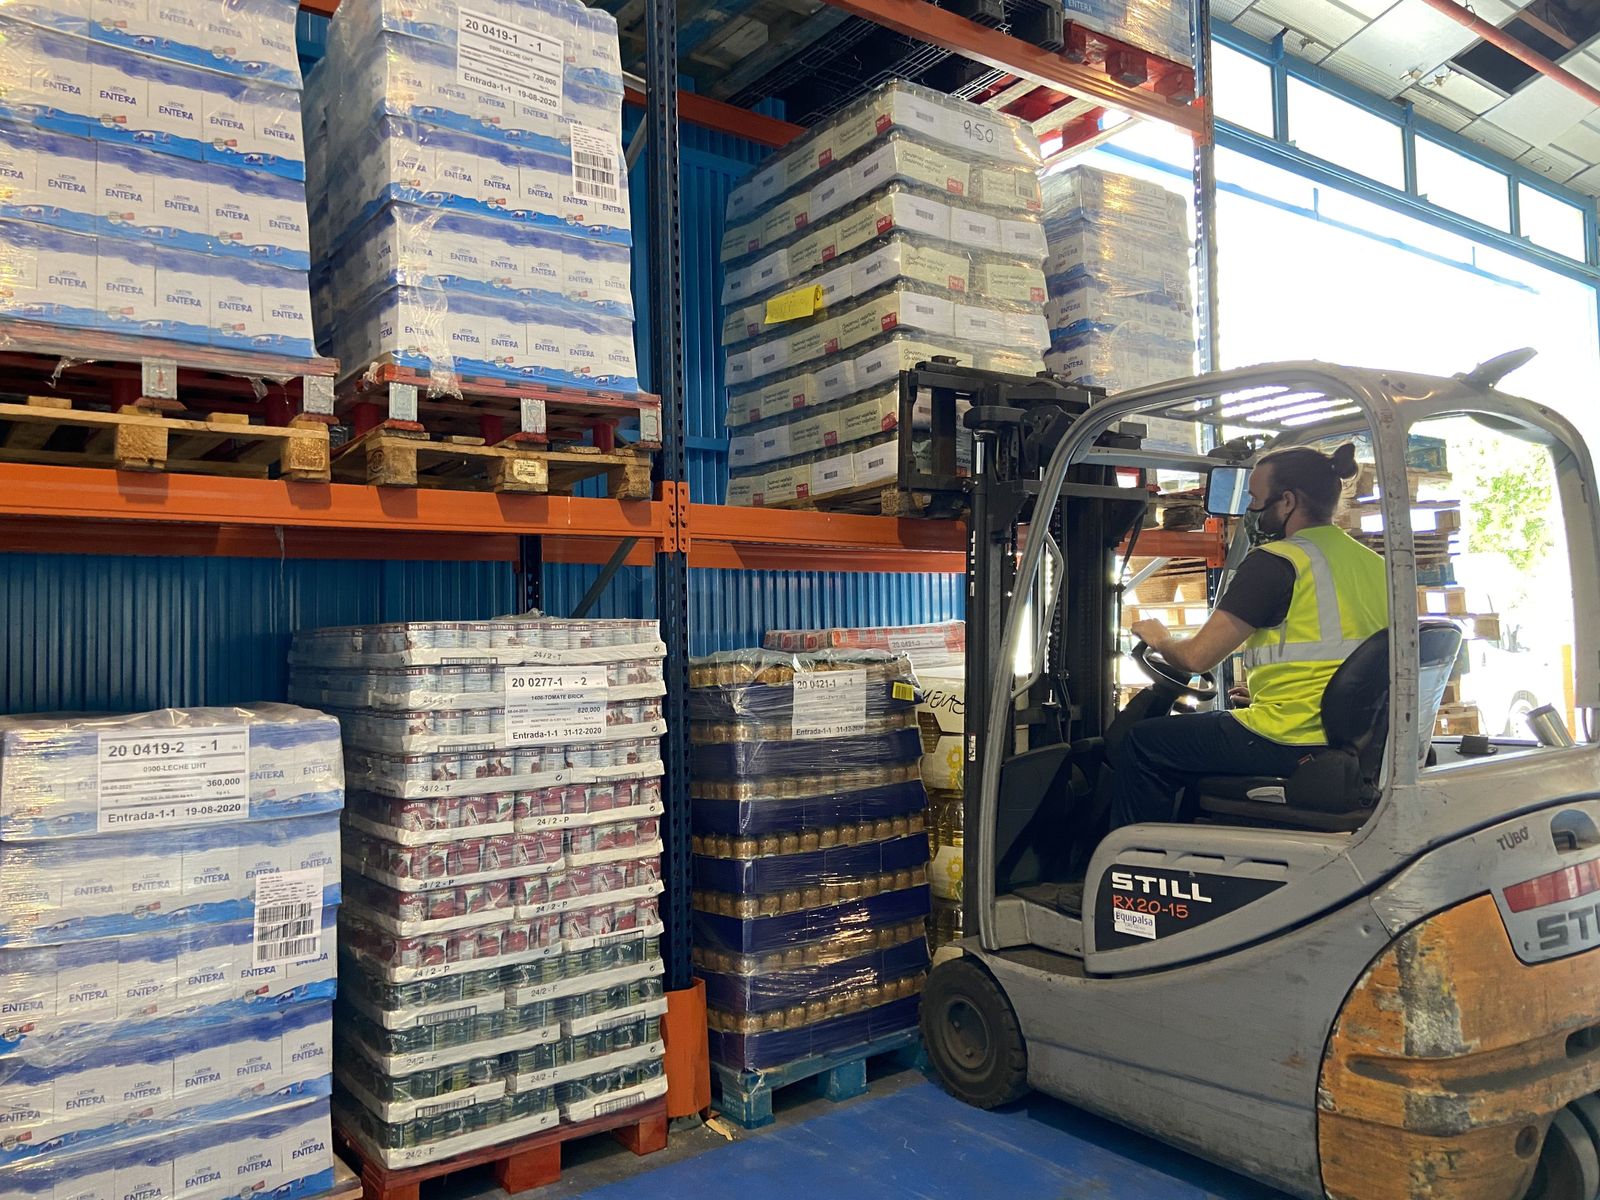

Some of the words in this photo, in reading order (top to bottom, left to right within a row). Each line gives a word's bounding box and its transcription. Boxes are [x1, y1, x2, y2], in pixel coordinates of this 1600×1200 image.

[465, 19, 479, 31] 20
[482, 25, 518, 44] 0419-1
[532, 73, 557, 86] 720,000
[464, 72, 511, 93] Entrada-1-1
[518, 90, 557, 107] 19-08-2020
[100, 90, 136, 105] ENTERA
[478, 96, 506, 108] ENTERA
[158, 105, 194, 121] ENTERA
[523, 107, 549, 120] ENTERA
[210, 116, 244, 131] ENTERA
[264, 127, 295, 141] ENTERA
[963, 119, 994, 143] 950
[444, 170, 472, 182] ENTERA
[48, 179, 87, 193] ENTERA
[483, 179, 511, 192] ENTERA
[105, 188, 143, 202] ENTERA
[528, 188, 553, 199] ENTERA
[164, 200, 200, 214] ENTERA
[563, 196, 588, 206] ENTERA
[216, 208, 250, 221] ENTERA
[602, 204, 625, 214] ENTERA
[269, 220, 301, 232] ENTERA
[450, 253, 478, 264] ENTERA
[490, 260, 518, 271] ENTERA
[531, 266, 557, 277] ENTERA
[48, 275, 87, 289] ENTERA
[568, 275, 593, 285] ENTERA
[106, 282, 144, 295] ENTERA
[166, 294, 202, 307] ENTERA
[218, 301, 253, 313] ENTERA
[272, 309, 304, 321] ENTERA
[452, 333, 480, 344] ENTERA
[491, 339, 519, 349] ENTERA
[535, 343, 560, 353] ENTERA
[569, 349, 595, 358] ENTERA
[608, 354, 630, 363] ENTERA
[1063, 360, 1083, 370] ENTERA
[512, 678, 525, 688] 20
[528, 677, 563, 687] 0277-1
[581, 677, 587, 686] 2
[797, 681, 808, 690] 20
[810, 680, 836, 689] 0421-1
[512, 730, 558, 740] Entrada-1-1
[563, 727, 602, 737] 31-12-2020
[796, 726, 832, 736] Entrada-1-1
[108, 745, 127, 757] 20
[133, 741, 185, 756] 0419-2
[250, 770, 284, 780] ENTERA
[303, 764, 332, 776] ENTERA
[206, 778, 241, 787] 360,000
[108, 808, 176, 823] Entrada-1-1
[185, 803, 241, 816] 19-08-2020
[301, 856, 332, 869] ENTERA
[194, 873, 230, 885] ENTERA
[74, 885, 113, 896] ENTERA
[132, 880, 171, 892] ENTERA
[1112, 872, 1212, 903] STILL
[1115, 911, 1153, 926] Equipalsa
[241, 965, 276, 978] ENTERA
[188, 972, 225, 985] ENTERA
[69, 990, 109, 1003] ENTERA
[2, 1001, 43, 1013] ENTERA
[292, 1047, 324, 1062] ENTERA
[236, 1062, 272, 1076] ENTERA
[185, 1073, 221, 1088] ENTERA
[124, 1087, 162, 1101] ENTERA
[66, 1095, 105, 1110] ENTERA
[0, 1110, 40, 1123] ENTERA
[292, 1142, 325, 1159] ENTERA
[237, 1158, 273, 1175] ENTERA
[185, 1171, 221, 1188] ENTERA
[124, 1188, 162, 1200] ENTERA
